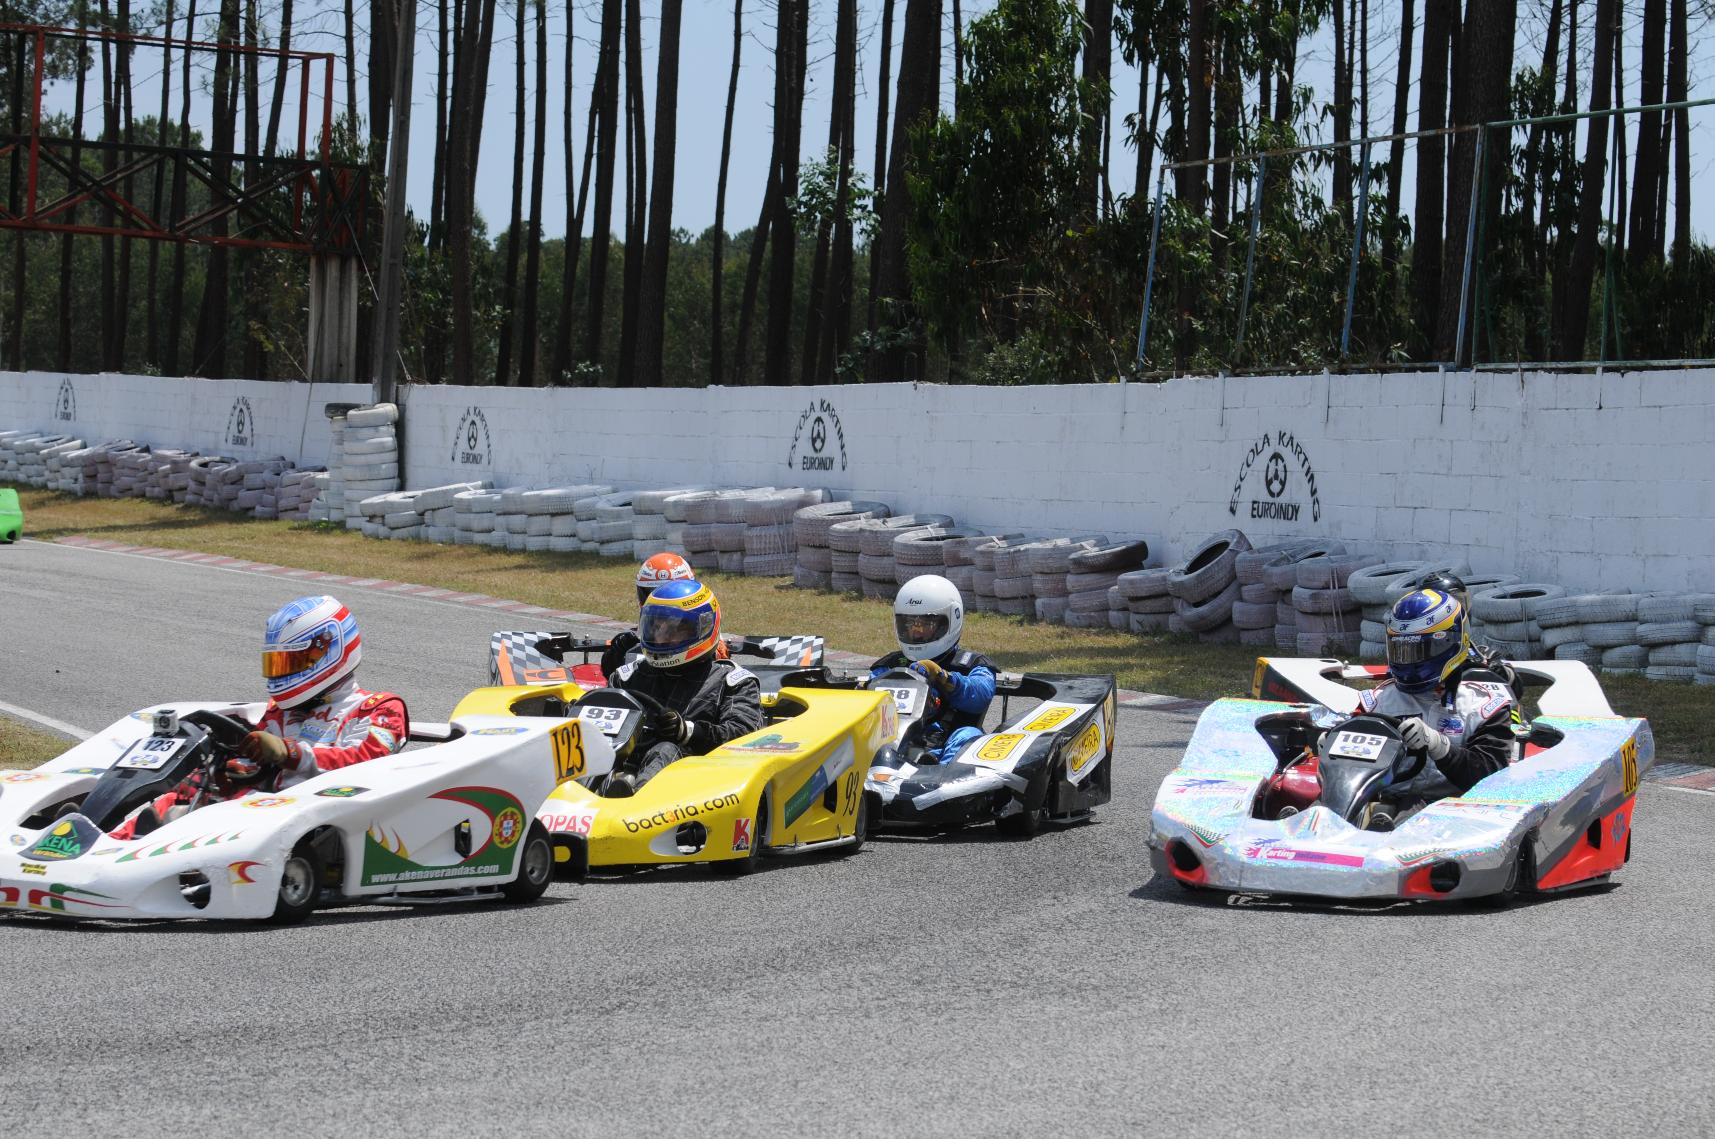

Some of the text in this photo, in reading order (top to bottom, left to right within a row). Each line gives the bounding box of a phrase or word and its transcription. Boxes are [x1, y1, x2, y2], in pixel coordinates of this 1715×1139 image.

[820, 398, 848, 472] KARTING
[802, 455, 835, 471] EUROINDY
[1229, 430, 1321, 522] ESCOLA KARTING
[1250, 500, 1300, 521] EUROINDY
[585, 707, 624, 721] 93
[143, 740, 176, 752] 123
[1341, 734, 1383, 746] 105
[551, 722, 586, 780] 123
[1621, 741, 1637, 794] 105
[842, 771, 860, 816] 93
[1256, 847, 1297, 860] Karting
[371, 864, 499, 883] www.akenaverandas.com
